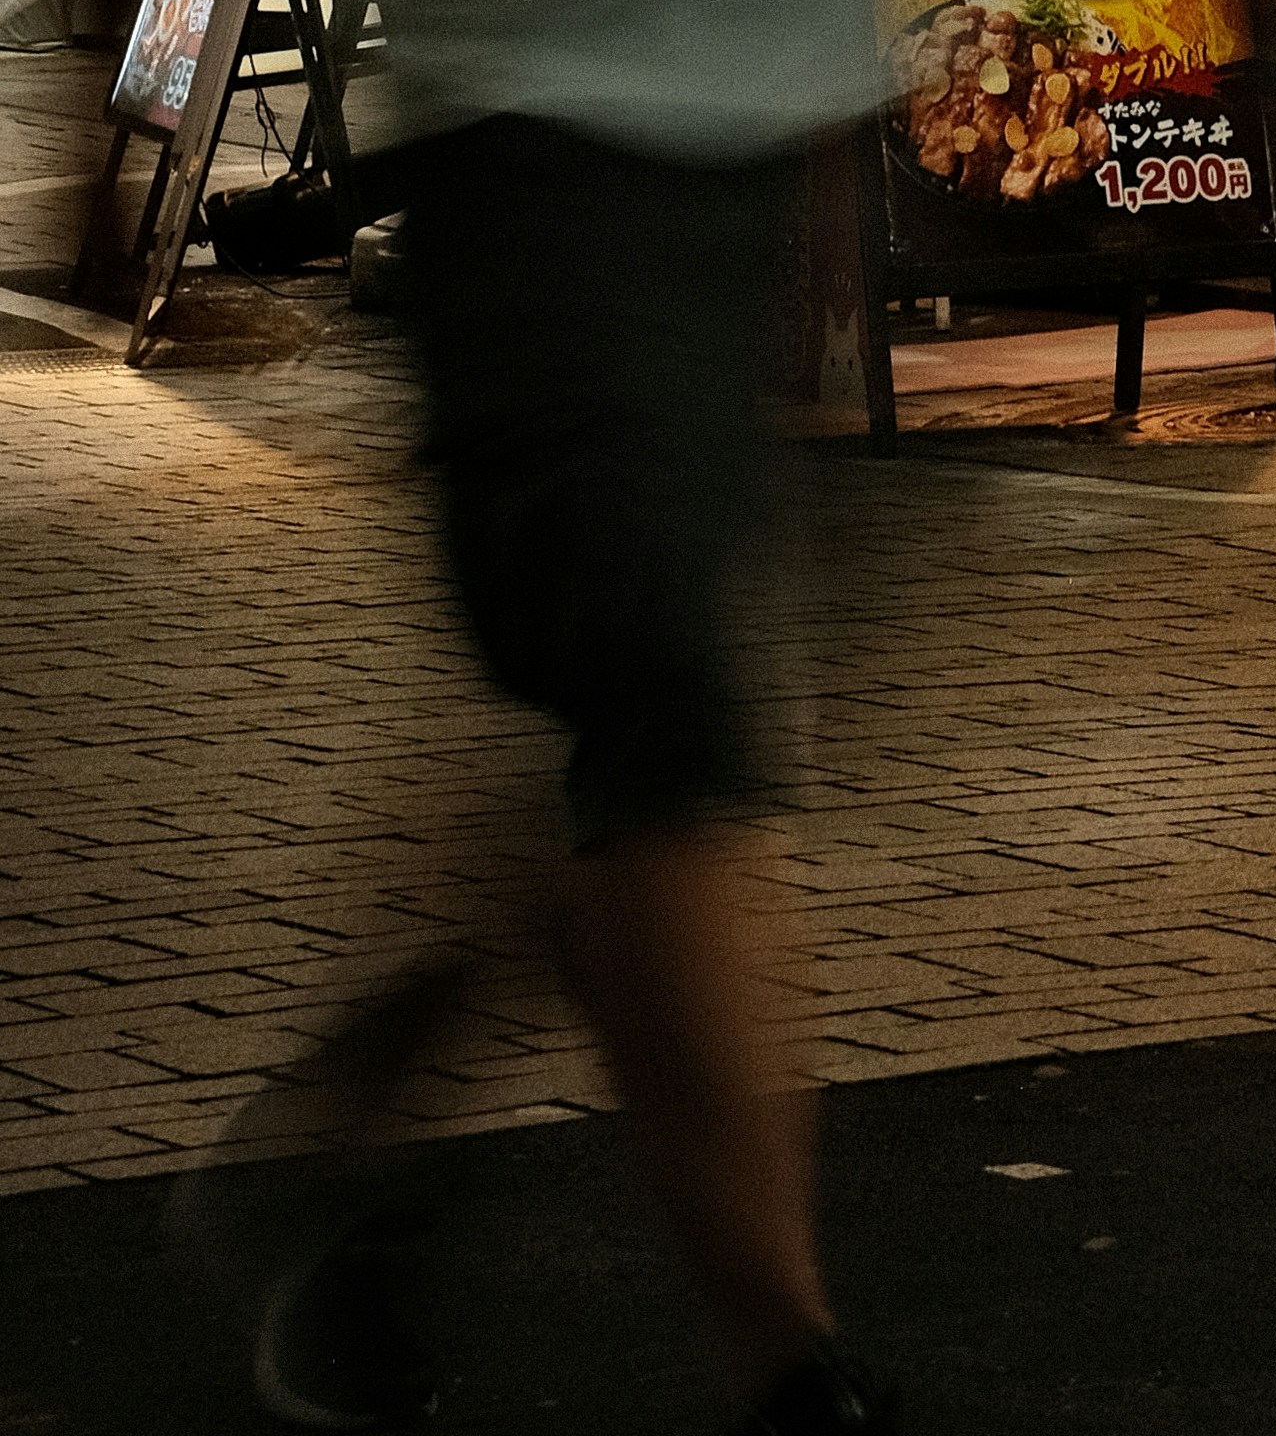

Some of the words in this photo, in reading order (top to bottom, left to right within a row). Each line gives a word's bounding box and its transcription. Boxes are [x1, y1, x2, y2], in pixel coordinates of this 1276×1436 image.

[1097, 99, 1162, 120] すたみな
[1107, 113, 1234, 153] トンテキ丼
[1095, 153, 1252, 214] 1,200円
